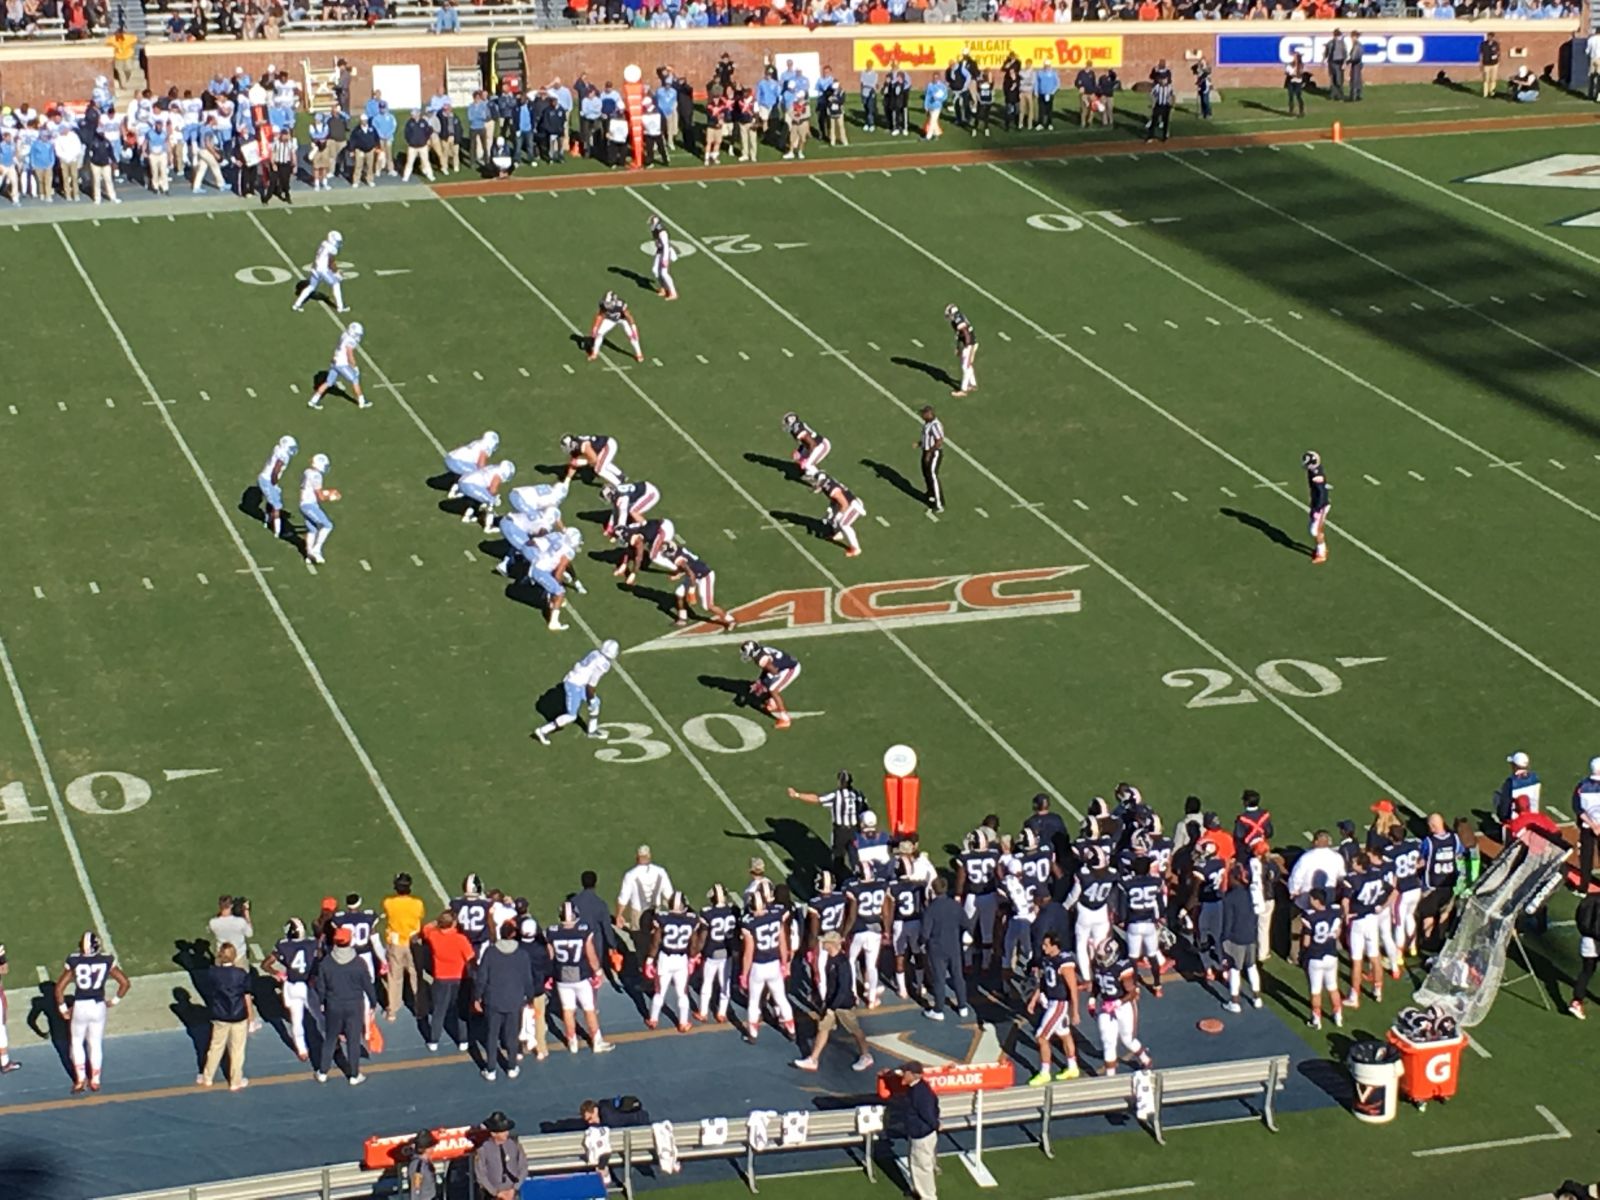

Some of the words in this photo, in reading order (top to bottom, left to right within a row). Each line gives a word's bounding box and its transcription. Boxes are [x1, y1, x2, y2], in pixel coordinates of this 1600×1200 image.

[1161, 658, 1343, 709] 20
[594, 713, 767, 763] 30
[858, 889, 885, 916] 29
[1128, 885, 1158, 909] 25
[458, 905, 486, 931] 42
[821, 902, 846, 931] 27
[663, 923, 693, 950] 22
[756, 920, 781, 951] 52
[290, 949, 307, 974] 4
[552, 938, 583, 963] 57
[75, 963, 107, 990] 87
[929, 1073, 983, 1088] TORADE
[1425, 1052, 1452, 1084] G
